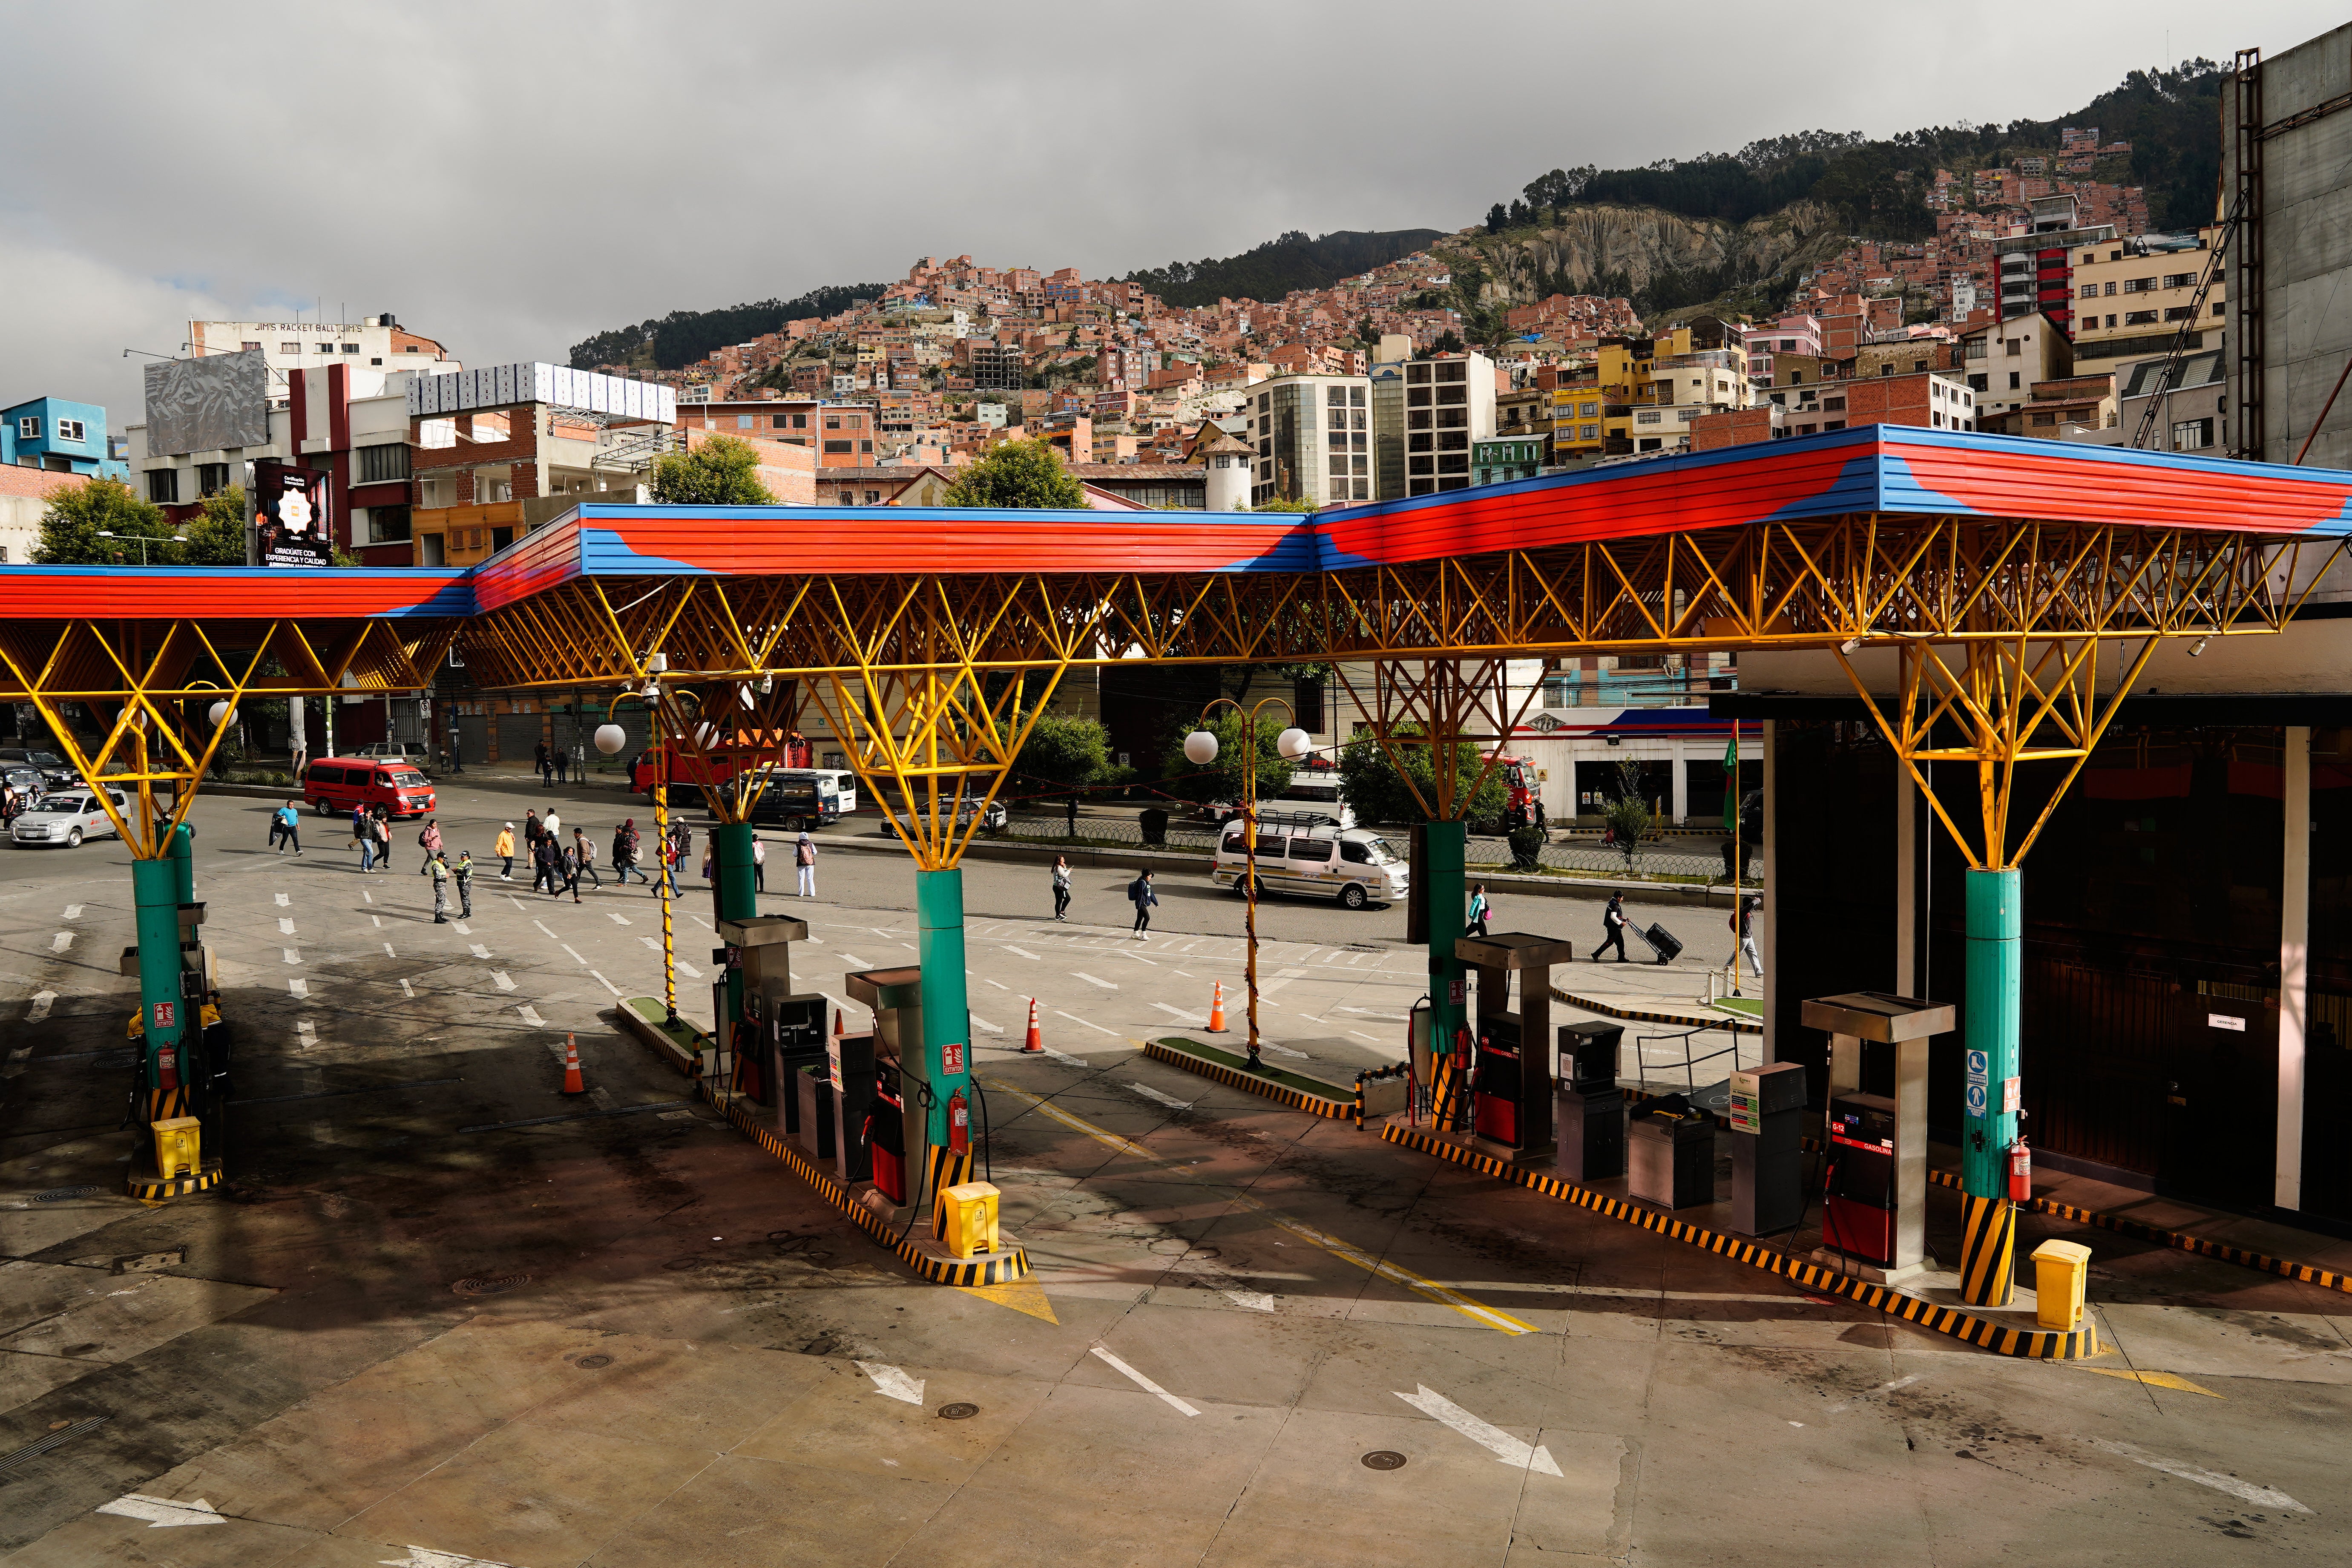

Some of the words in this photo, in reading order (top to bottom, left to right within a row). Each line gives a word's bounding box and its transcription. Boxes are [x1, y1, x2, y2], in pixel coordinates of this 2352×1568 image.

[275, 547, 303, 556] GRADÚATE
[265, 554, 300, 563] EXPERIENCIA
[1501, 1050, 1519, 1059] GASOLINA
[1832, 1123, 1844, 1132] G-12
[1864, 1143, 1892, 1155] GASOLINA
